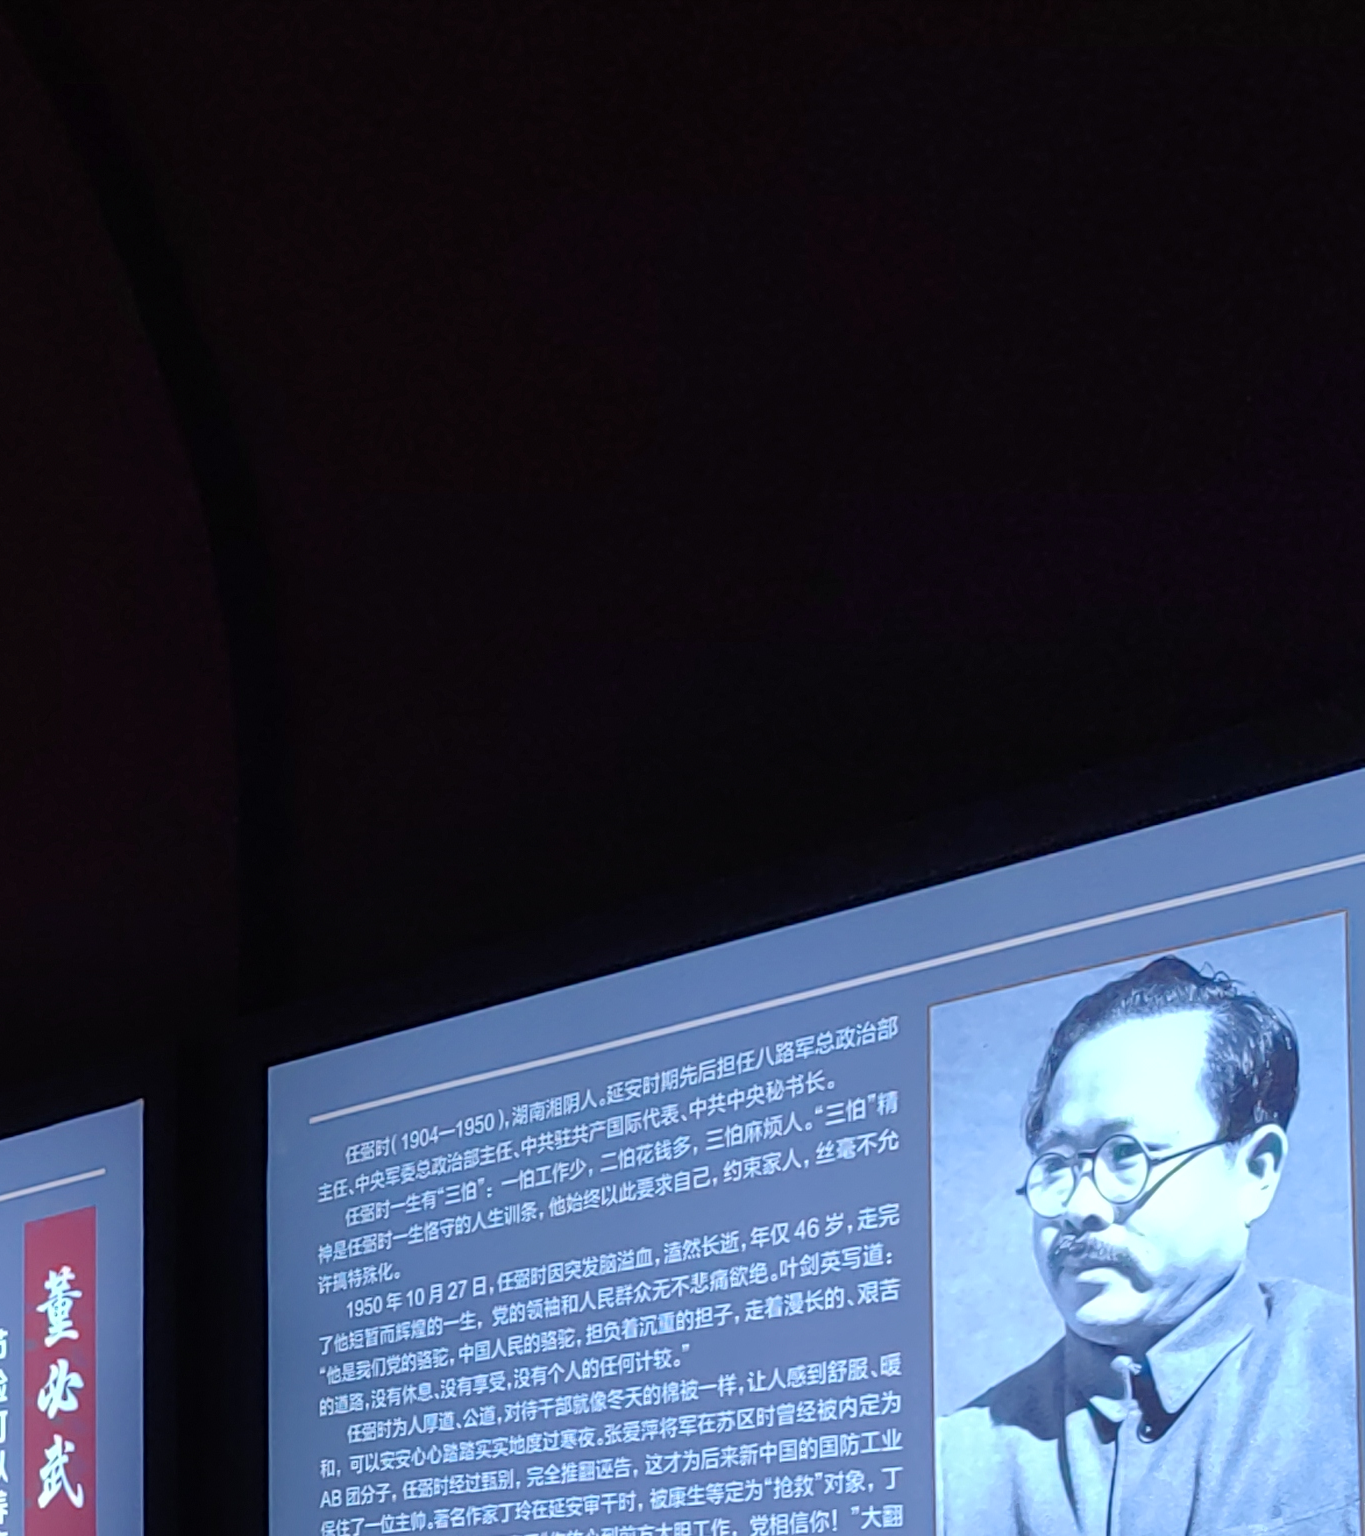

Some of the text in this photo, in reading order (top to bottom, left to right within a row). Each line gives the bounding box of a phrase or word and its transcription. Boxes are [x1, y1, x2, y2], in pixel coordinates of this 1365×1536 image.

[317, 1261, 401, 1295] 许搞特殊化。
[36, 1264, 85, 1510] 董必武
